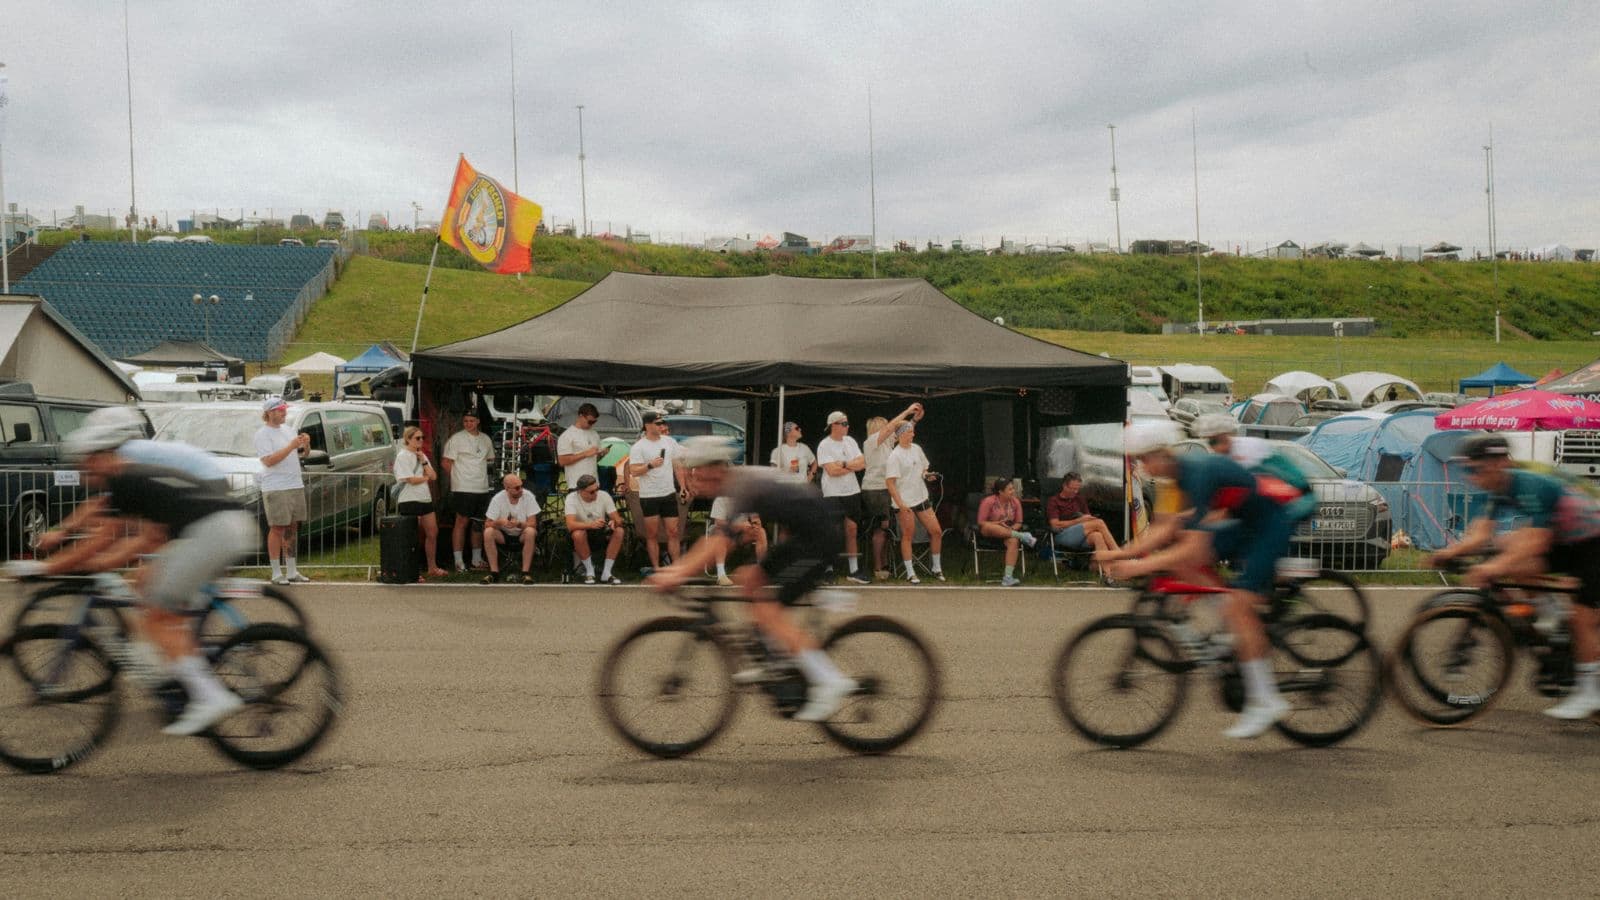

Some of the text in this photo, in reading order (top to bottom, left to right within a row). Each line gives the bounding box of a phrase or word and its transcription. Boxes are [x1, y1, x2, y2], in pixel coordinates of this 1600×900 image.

[1461, 415, 1476, 427] part
[1477, 415, 1486, 425] of
[1486, 415, 1498, 425] the
[1498, 416, 1518, 428] party
